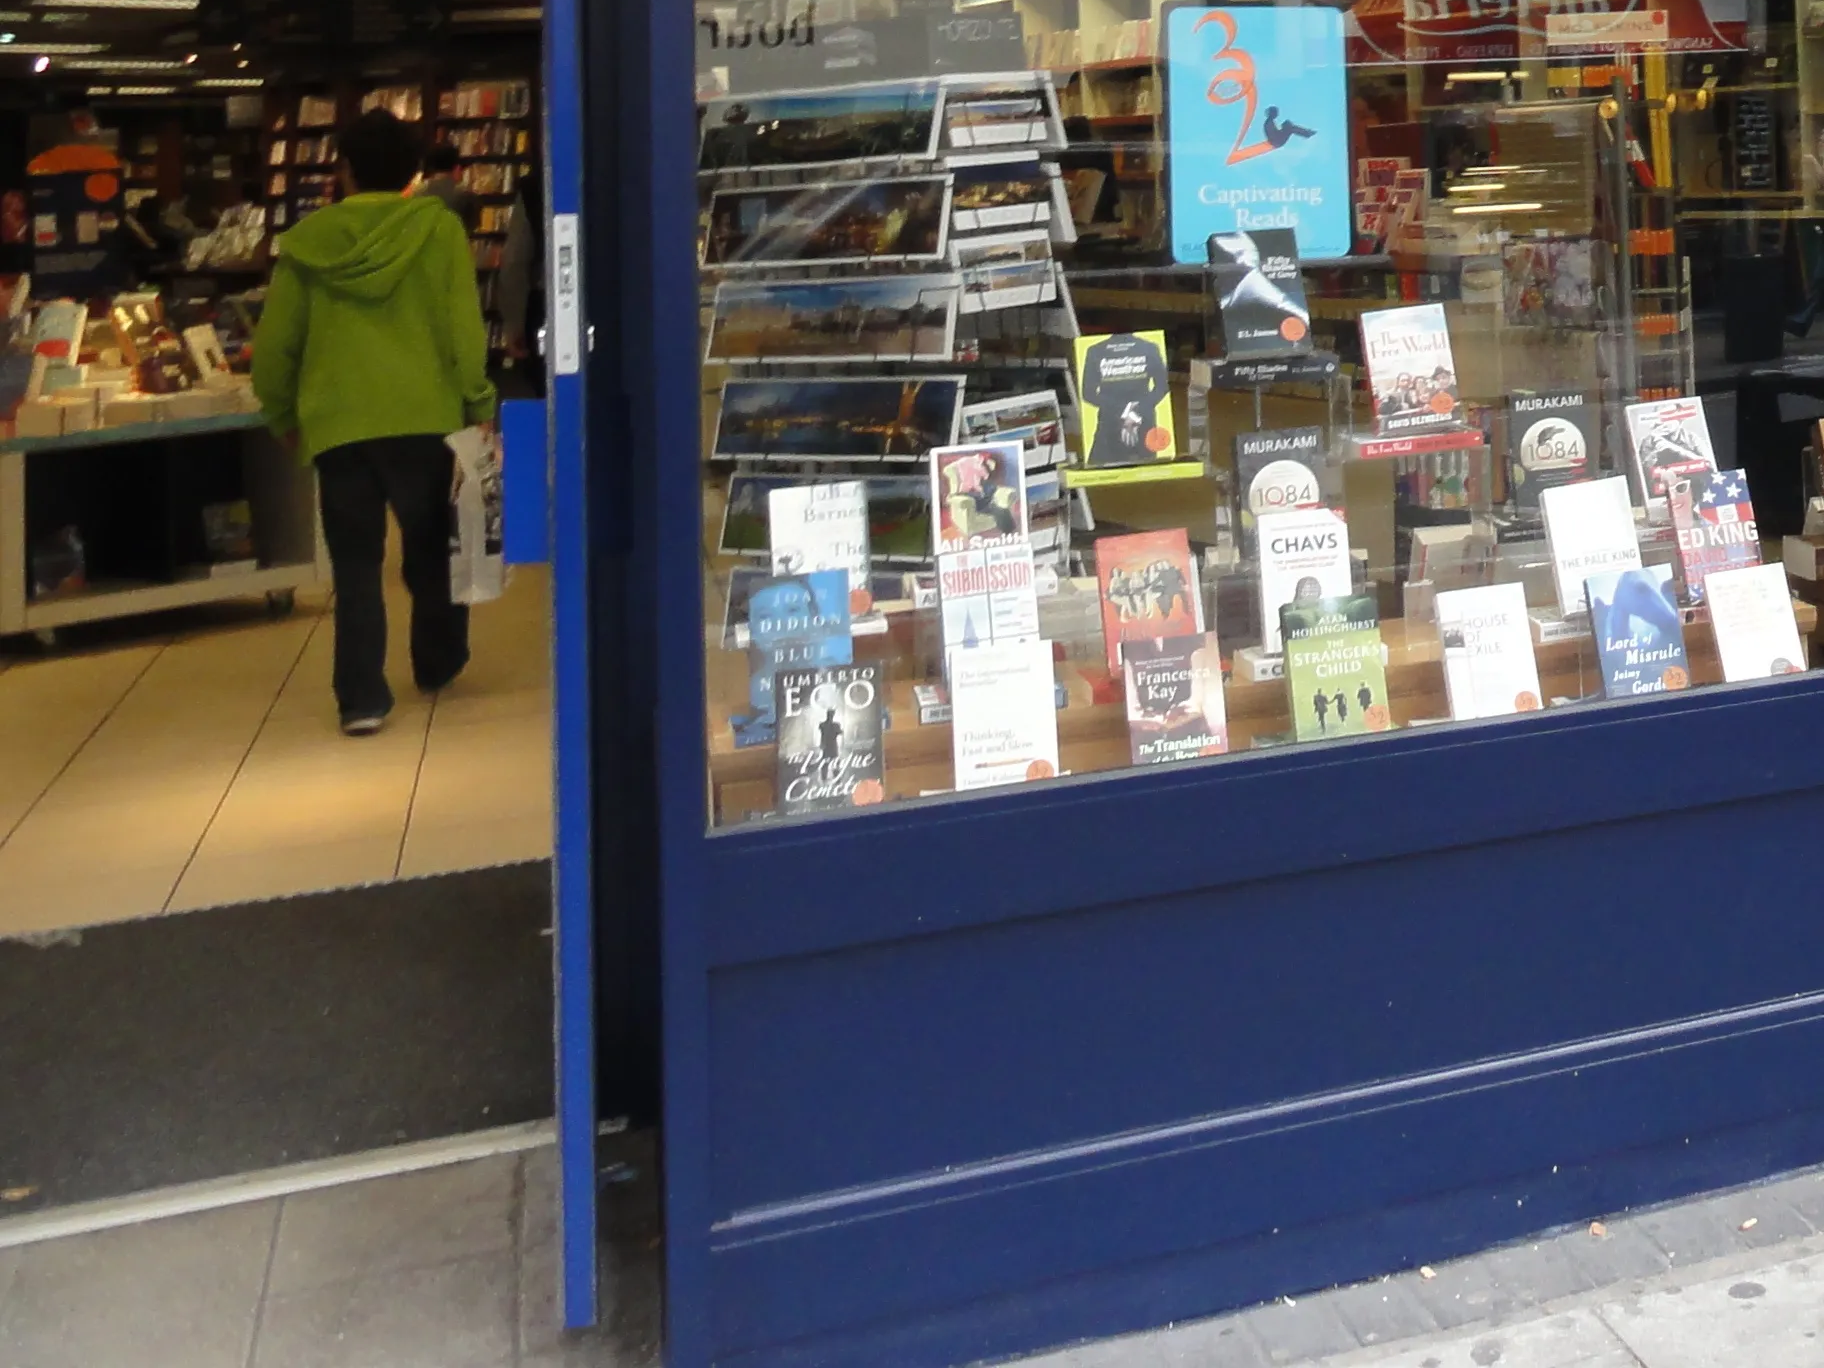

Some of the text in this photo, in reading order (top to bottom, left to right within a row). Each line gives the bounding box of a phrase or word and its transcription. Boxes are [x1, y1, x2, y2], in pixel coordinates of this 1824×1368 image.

[1198, 184, 1322, 208] Captivating
[1235, 206, 1299, 228] Reads
[1402, 331, 1447, 355] World
[1515, 394, 1584, 413] MURAKAMI
[1243, 435, 1318, 456] MURAKAMI
[1271, 532, 1339, 555] CHAVS
[1677, 520, 1760, 551] ED KING
[1560, 547, 1638, 570] THE PALE KING
[942, 560, 1031, 597] SUBMISSION
[759, 614, 842, 635] DIDION
[1291, 617, 1377, 640] HOLLINGHURST
[1463, 612, 1510, 630] HOUSE
[1606, 631, 1653, 653] Lord of
[774, 644, 829, 665] BLUE
[1293, 641, 1381, 668] STRANGER'S
[1626, 643, 1682, 667] Misrule
[782, 666, 876, 688] UMBERTO
[1138, 668, 1211, 687] Francesca
[1315, 660, 1363, 680] CHILD
[1147, 684, 1178, 702] Kay
[1632, 677, 1668, 695] Gord
[785, 679, 876, 719] ECO
[1154, 734, 1221, 754] Translation
[799, 747, 877, 784] Prague
